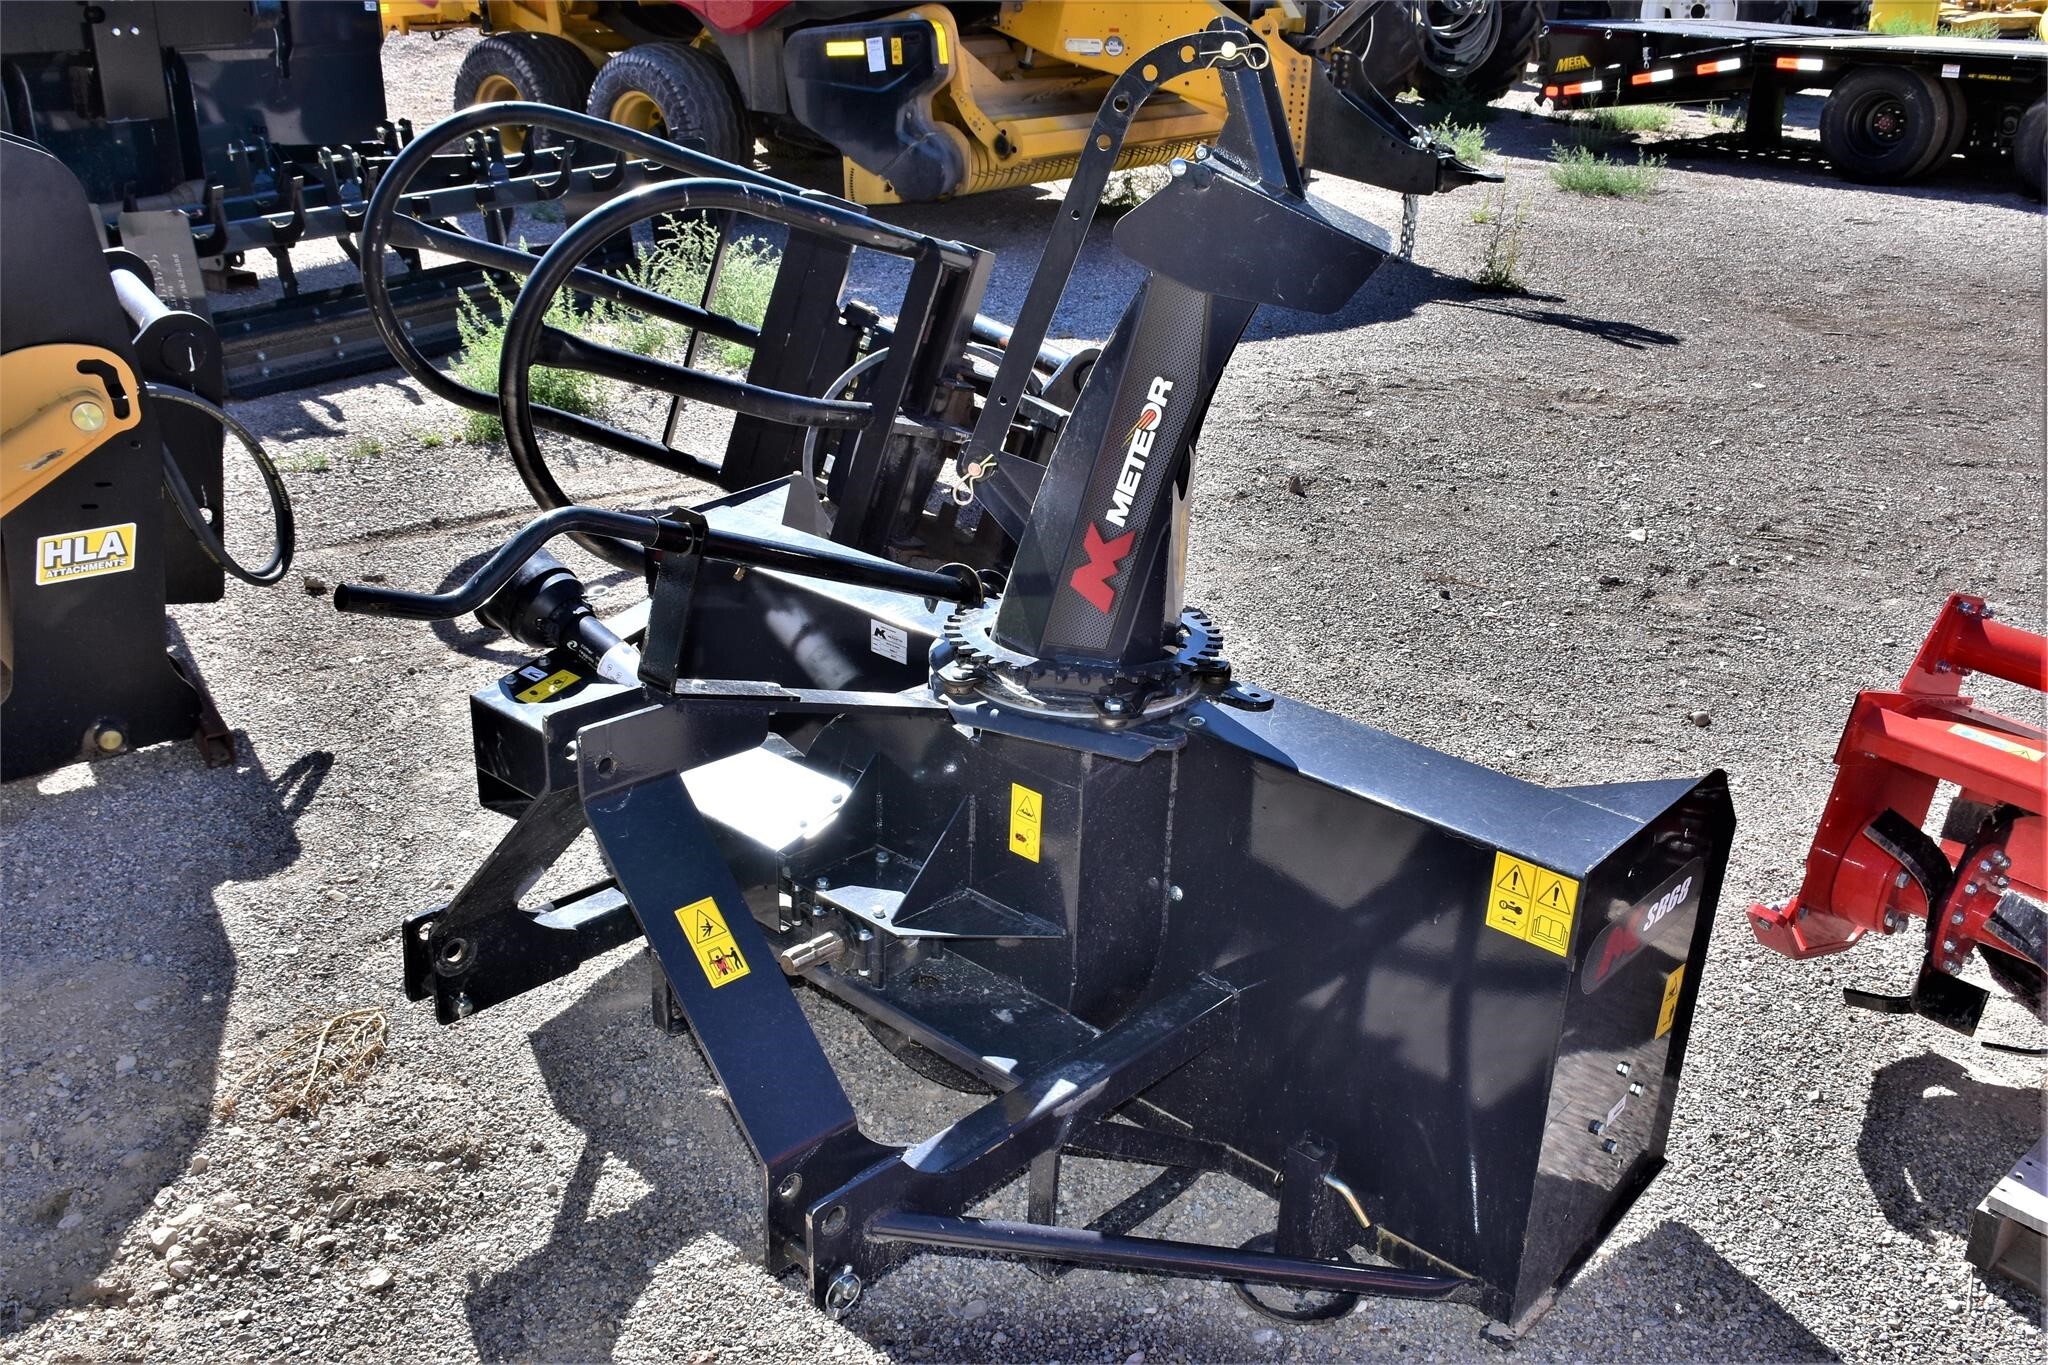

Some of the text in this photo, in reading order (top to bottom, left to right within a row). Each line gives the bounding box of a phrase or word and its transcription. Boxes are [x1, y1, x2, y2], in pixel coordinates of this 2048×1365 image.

[1555, 55, 1591, 72] MEGA
[1105, 376, 1174, 528] METEOR
[44, 531, 128, 569] HLA
[46, 559, 127, 578] ATTACHMENTS
[1643, 875, 1693, 932] SB68
